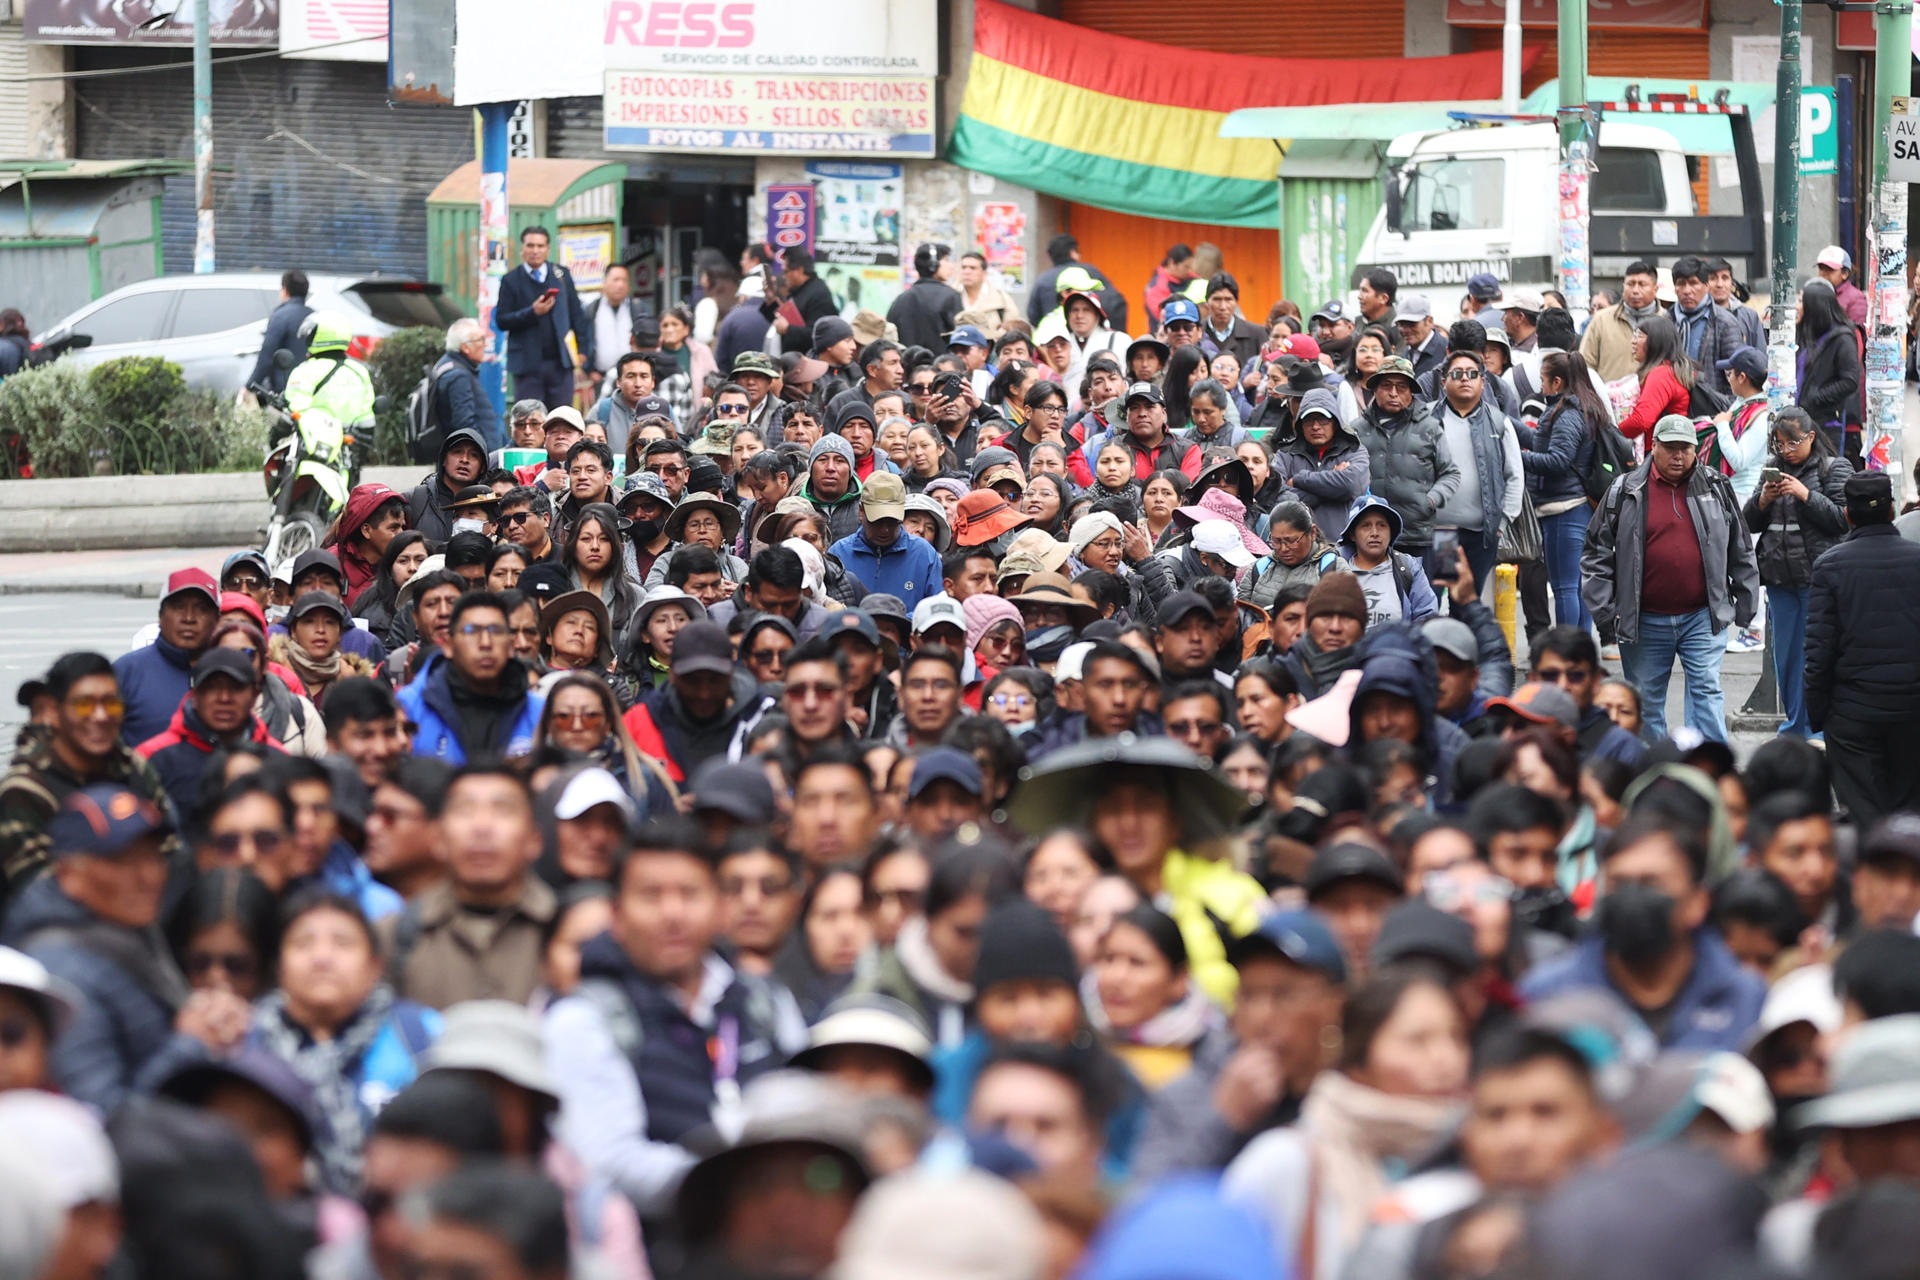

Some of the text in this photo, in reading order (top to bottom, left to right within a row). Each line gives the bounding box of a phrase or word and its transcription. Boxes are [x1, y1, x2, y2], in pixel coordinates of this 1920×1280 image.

[662, 53, 918, 67] SERVICIO DE CALIDAD CONTROLADA
[620, 77, 928, 102] FOTOCOPIAS TRANSCRIPCIONES
[621, 102, 749, 124] IMPRESIONES
[852, 108, 928, 128] CARTAS
[648, 128, 891, 150] FOTOS AL INSTANTE
[1895, 120, 1916, 136] AV.
[1894, 139, 1920, 160] SA
[1376, 259, 1510, 285] LICIA BOLIVIANA
